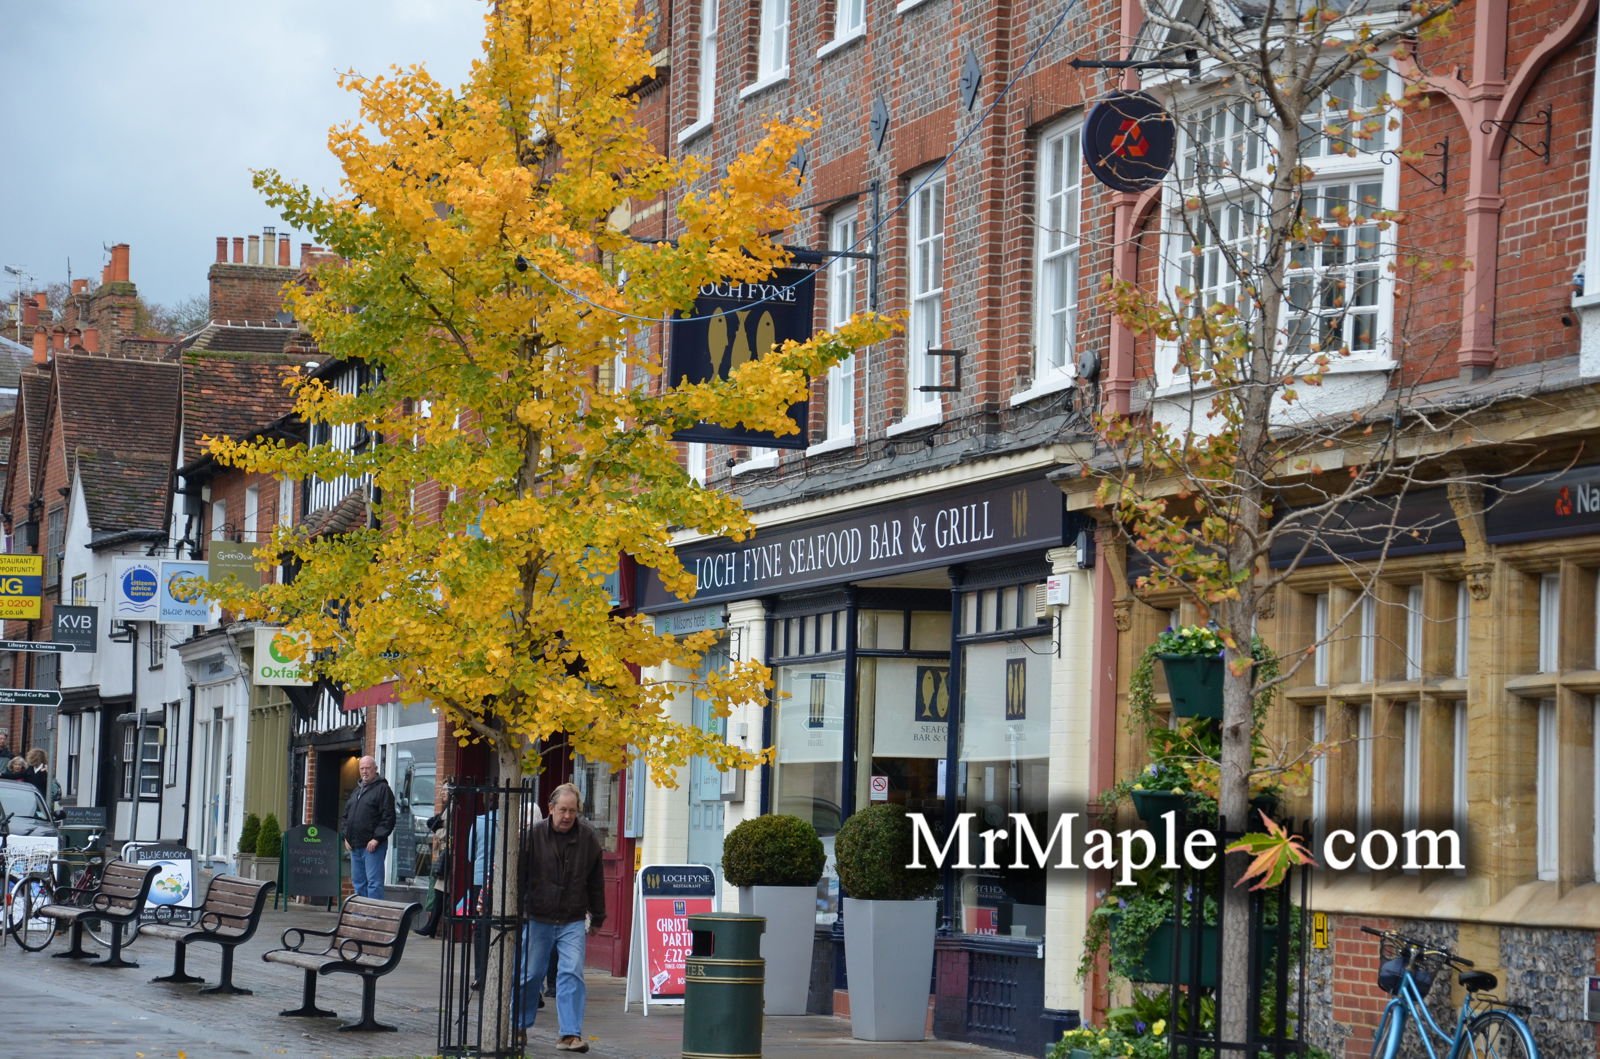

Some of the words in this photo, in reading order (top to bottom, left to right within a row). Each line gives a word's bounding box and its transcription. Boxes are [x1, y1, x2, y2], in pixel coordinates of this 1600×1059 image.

[698, 281, 743, 298] OCH
[747, 283, 797, 302] FYNE
[1577, 483, 1600, 513] Na
[695, 551, 737, 590] LOCH
[743, 542, 782, 583] FYNE
[789, 527, 862, 575] SEAFOOD
[869, 519, 903, 561] BAR
[911, 515, 927, 553] &
[934, 500, 994, 549] GRILL
[7, 599, 34, 608] 0200
[58, 614, 92, 629] KVB
[913, 734, 930, 742] BAR
[139, 851, 161, 860] BLUE
[162, 851, 188, 860] MOON
[662, 874, 688, 883] LOCH
[688, 874, 711, 883] FYNE
[656, 918, 692, 932] CHRIST
